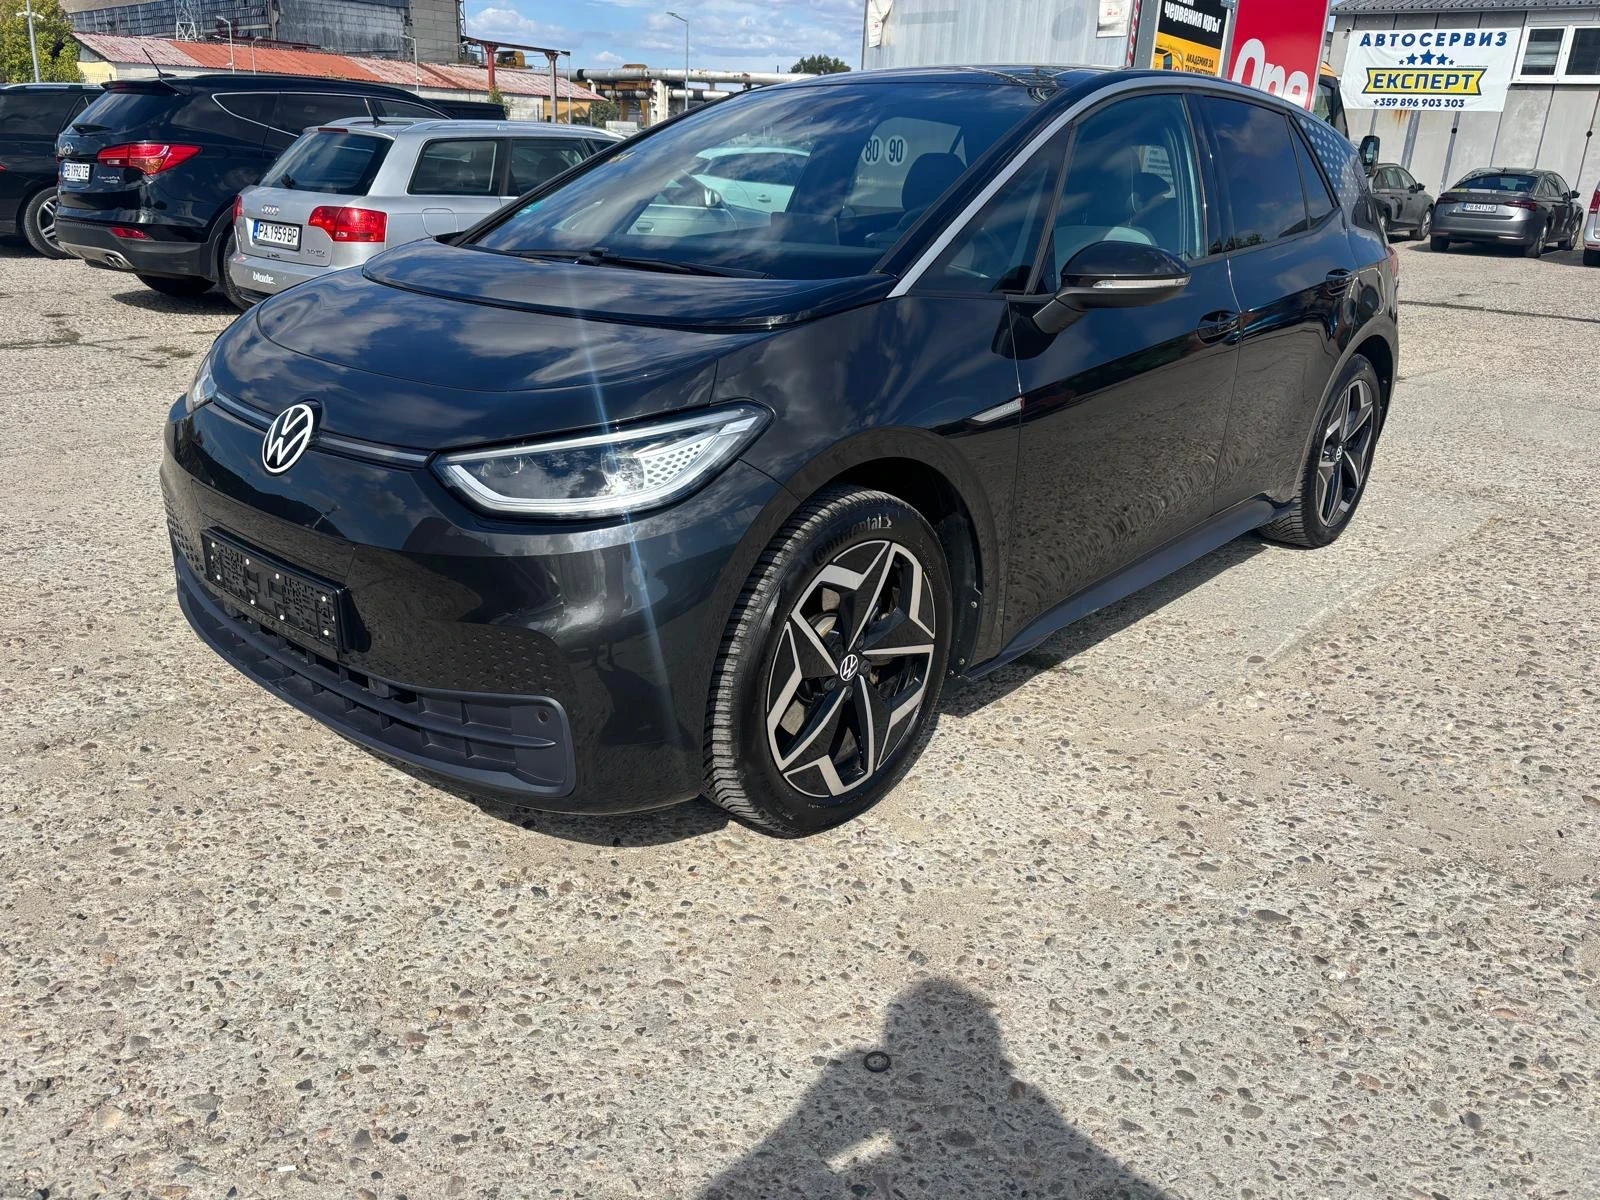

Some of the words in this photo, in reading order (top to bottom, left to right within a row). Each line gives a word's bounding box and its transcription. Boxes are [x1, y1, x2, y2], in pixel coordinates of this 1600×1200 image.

[1164, 1, 1203, 28] червения
[1202, 14, 1221, 33] кръг
[1359, 31, 1508, 47] АВТОСЕРВИЗ
[1372, 73, 1475, 90] ЕКСПЕРТ
[1373, 98, 1398, 107] +359
[1399, 98, 1419, 108] 896
[1421, 98, 1442, 108] 903
[1444, 99, 1465, 108] 303
[865, 138, 880, 162] 80
[888, 138, 904, 163] 90
